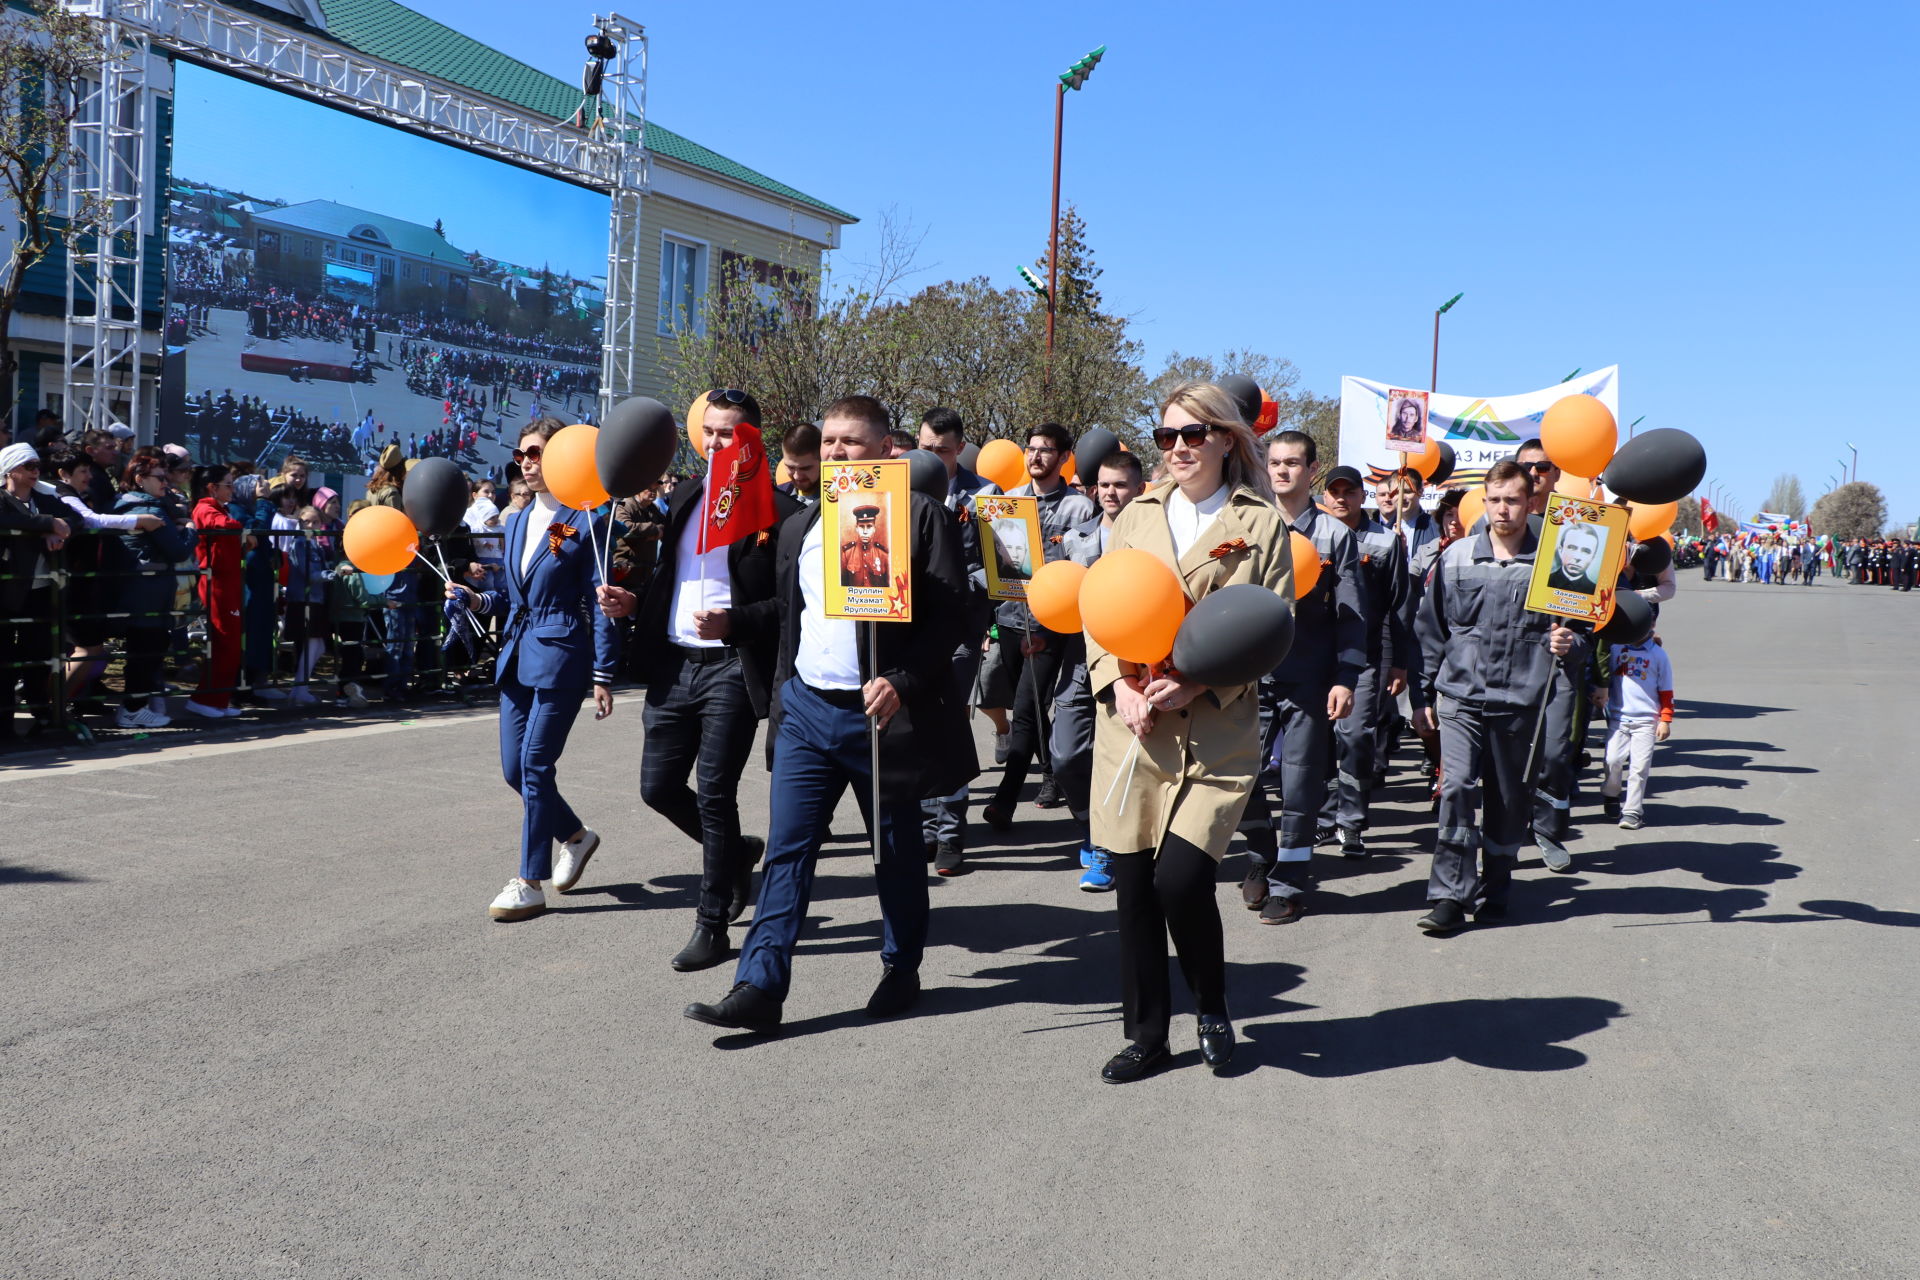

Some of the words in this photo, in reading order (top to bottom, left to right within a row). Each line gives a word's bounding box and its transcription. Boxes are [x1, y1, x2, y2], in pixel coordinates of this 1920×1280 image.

[847, 587, 883, 595] Яруллин
[1554, 589, 1588, 600] Закиров
[847, 596, 884, 604] Мухамат
[1560, 598, 1578, 606] Гали
[844, 605, 888, 614] Яруллович
[1546, 603, 1588, 615] Закирович
